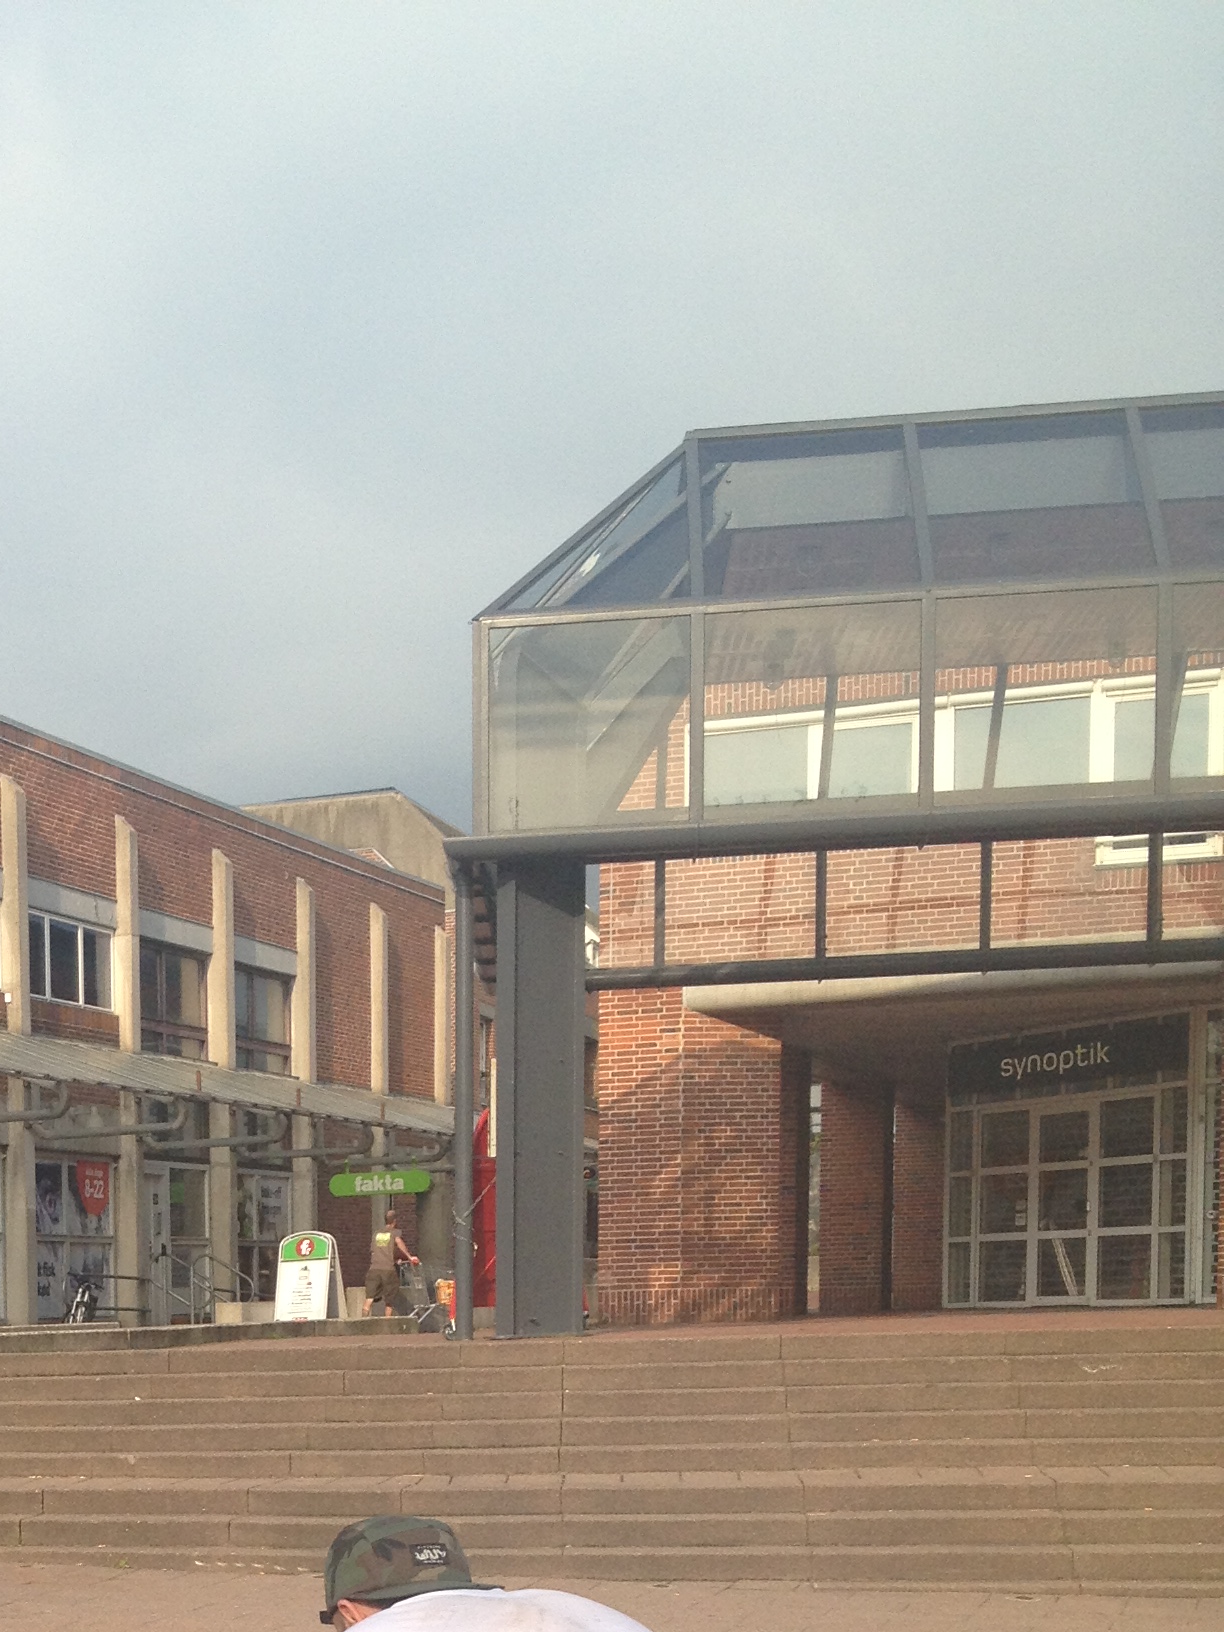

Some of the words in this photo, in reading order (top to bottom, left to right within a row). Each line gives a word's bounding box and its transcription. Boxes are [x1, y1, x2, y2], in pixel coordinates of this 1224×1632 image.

[1000, 1041, 1111, 1080] synoptik
[84, 1178, 105, 1199] 8-22
[354, 1174, 405, 1193] fakta
